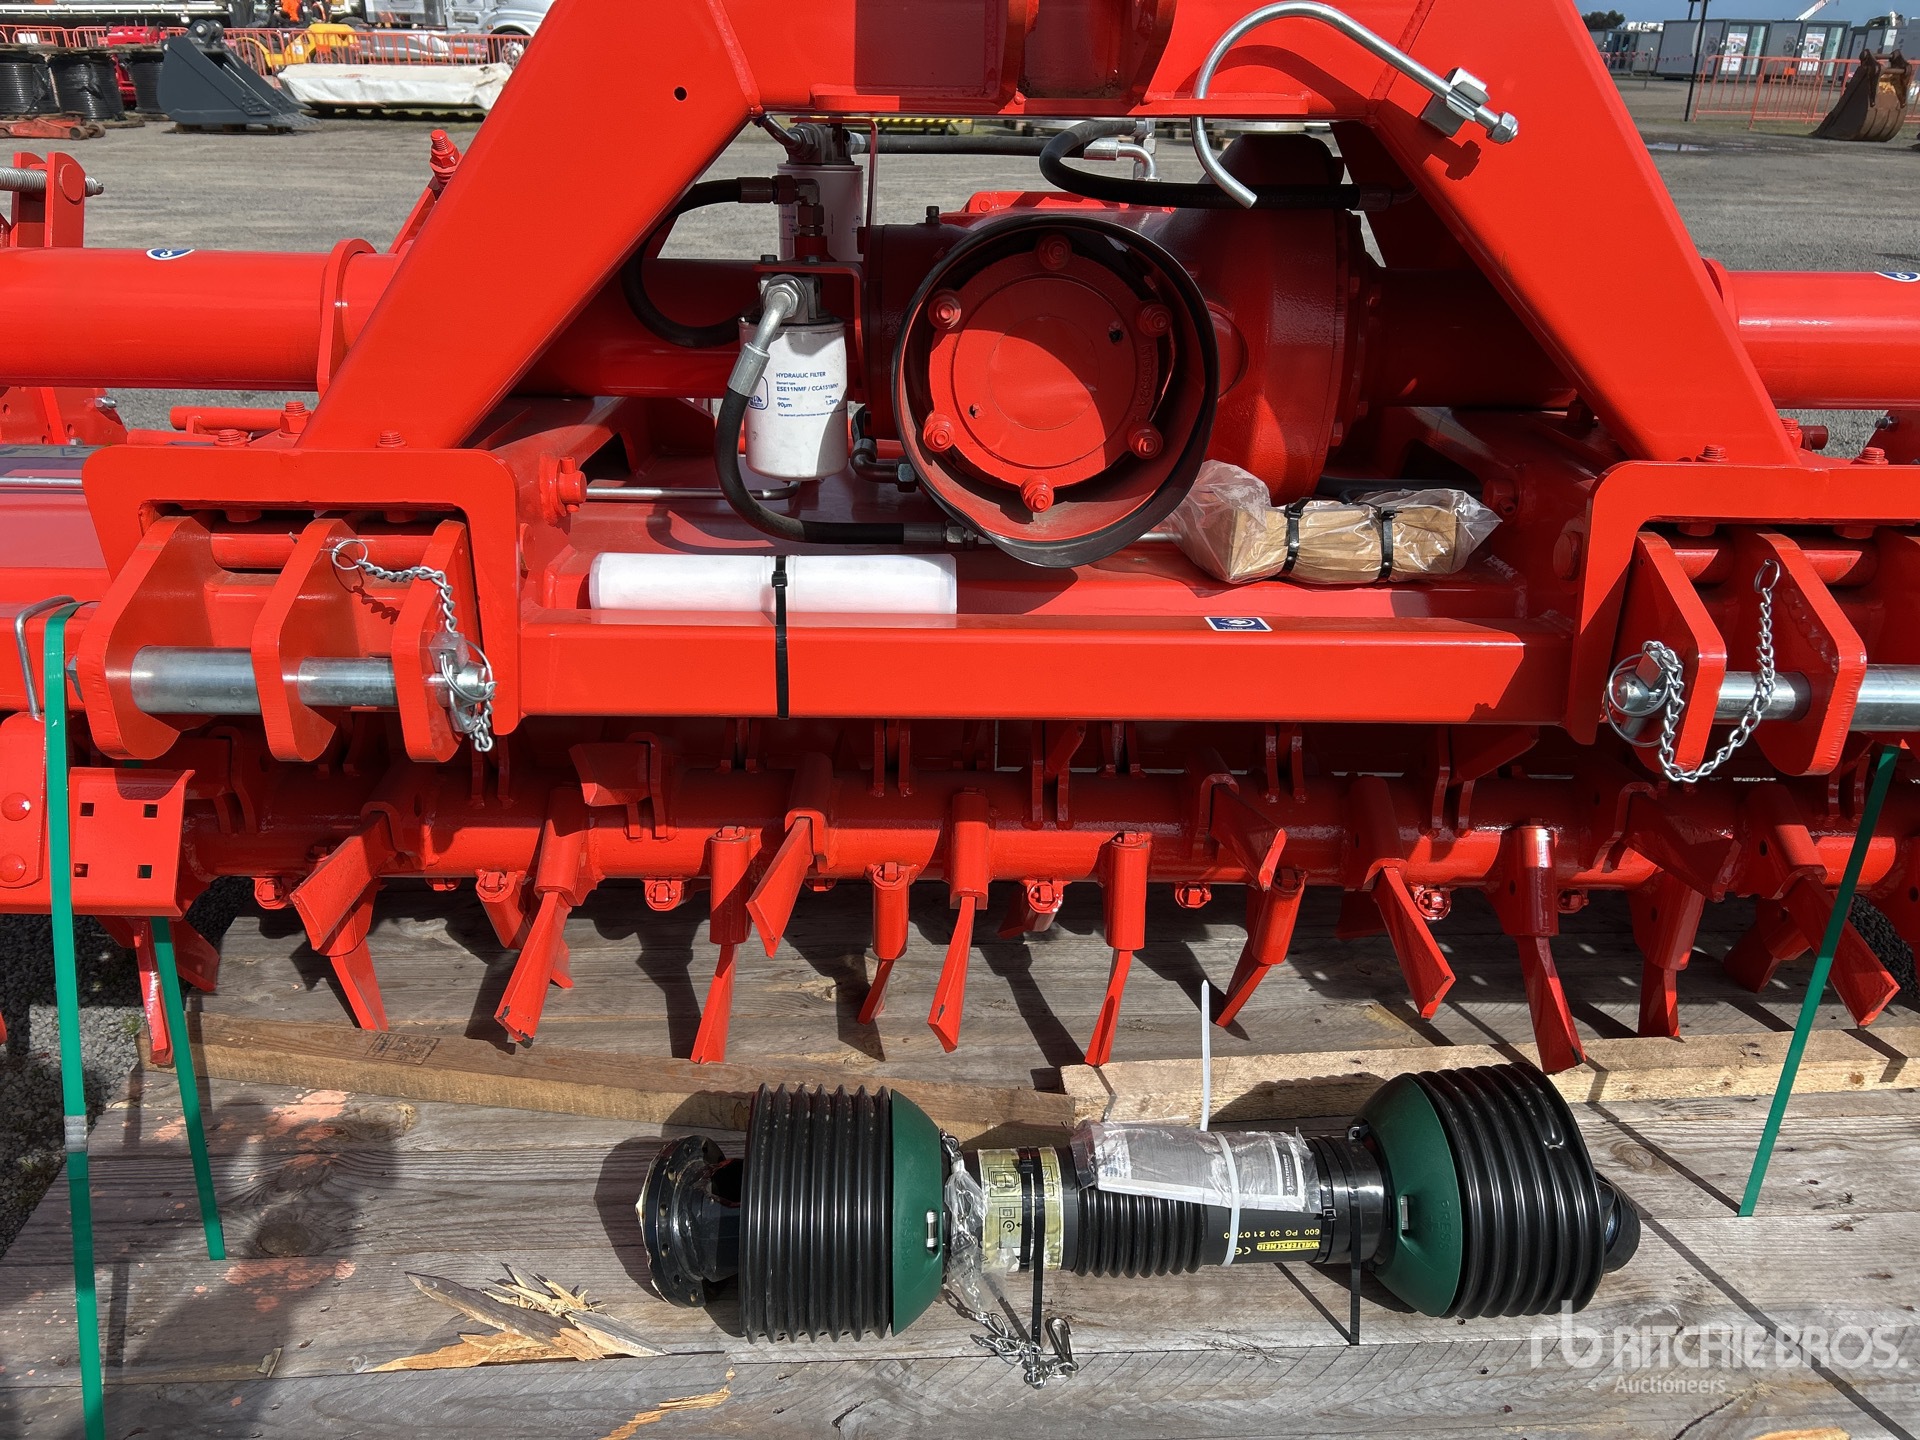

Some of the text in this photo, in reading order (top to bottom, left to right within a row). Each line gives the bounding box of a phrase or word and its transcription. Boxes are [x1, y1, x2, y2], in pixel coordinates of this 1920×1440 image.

[1269, 1230, 1280, 1238] 30
[1285, 1229, 1298, 1237] PG
[1304, 1228, 1320, 1236] 600
[1257, 1241, 1320, 1251] WALTERSCHEID
